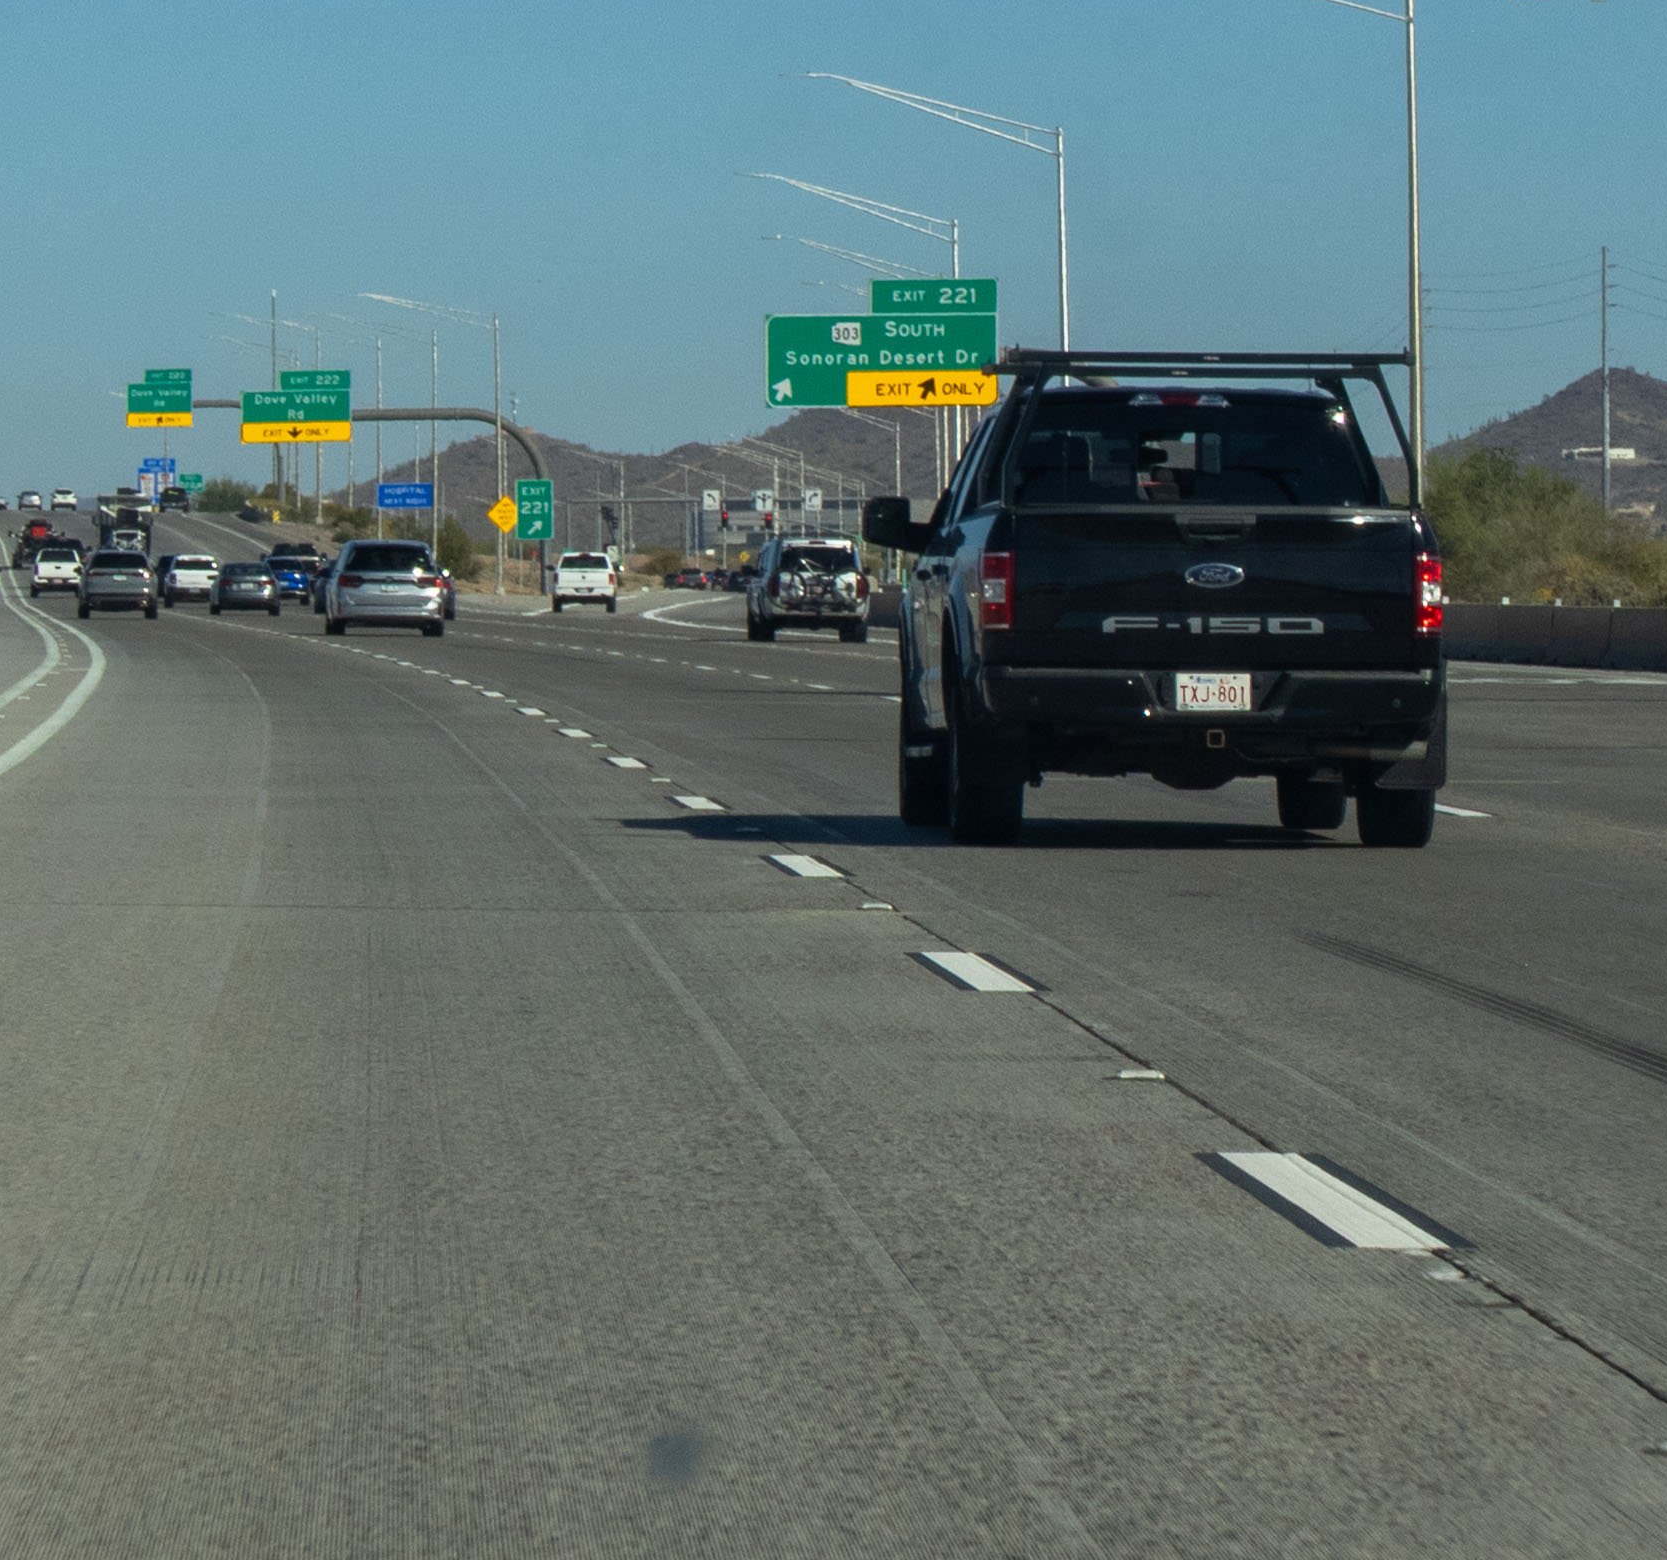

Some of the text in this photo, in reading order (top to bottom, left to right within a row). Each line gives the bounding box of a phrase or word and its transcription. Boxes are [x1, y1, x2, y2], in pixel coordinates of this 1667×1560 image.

[892, 287, 976, 305] EXIT 221
[833, 320, 946, 341] 303 SOUTH
[785, 348, 979, 366] Sonoran Desert Dr
[315, 374, 340, 385] 222
[875, 382, 985, 397] EXIT ONLY
[254, 393, 338, 406] Dove Valley
[287, 408, 305, 420] Rd
[262, 427, 329, 438] EXIT ONLY
[521, 486, 547, 496] EXIT
[520, 501, 549, 515] 221
[1101, 615, 1325, 634] F-150
